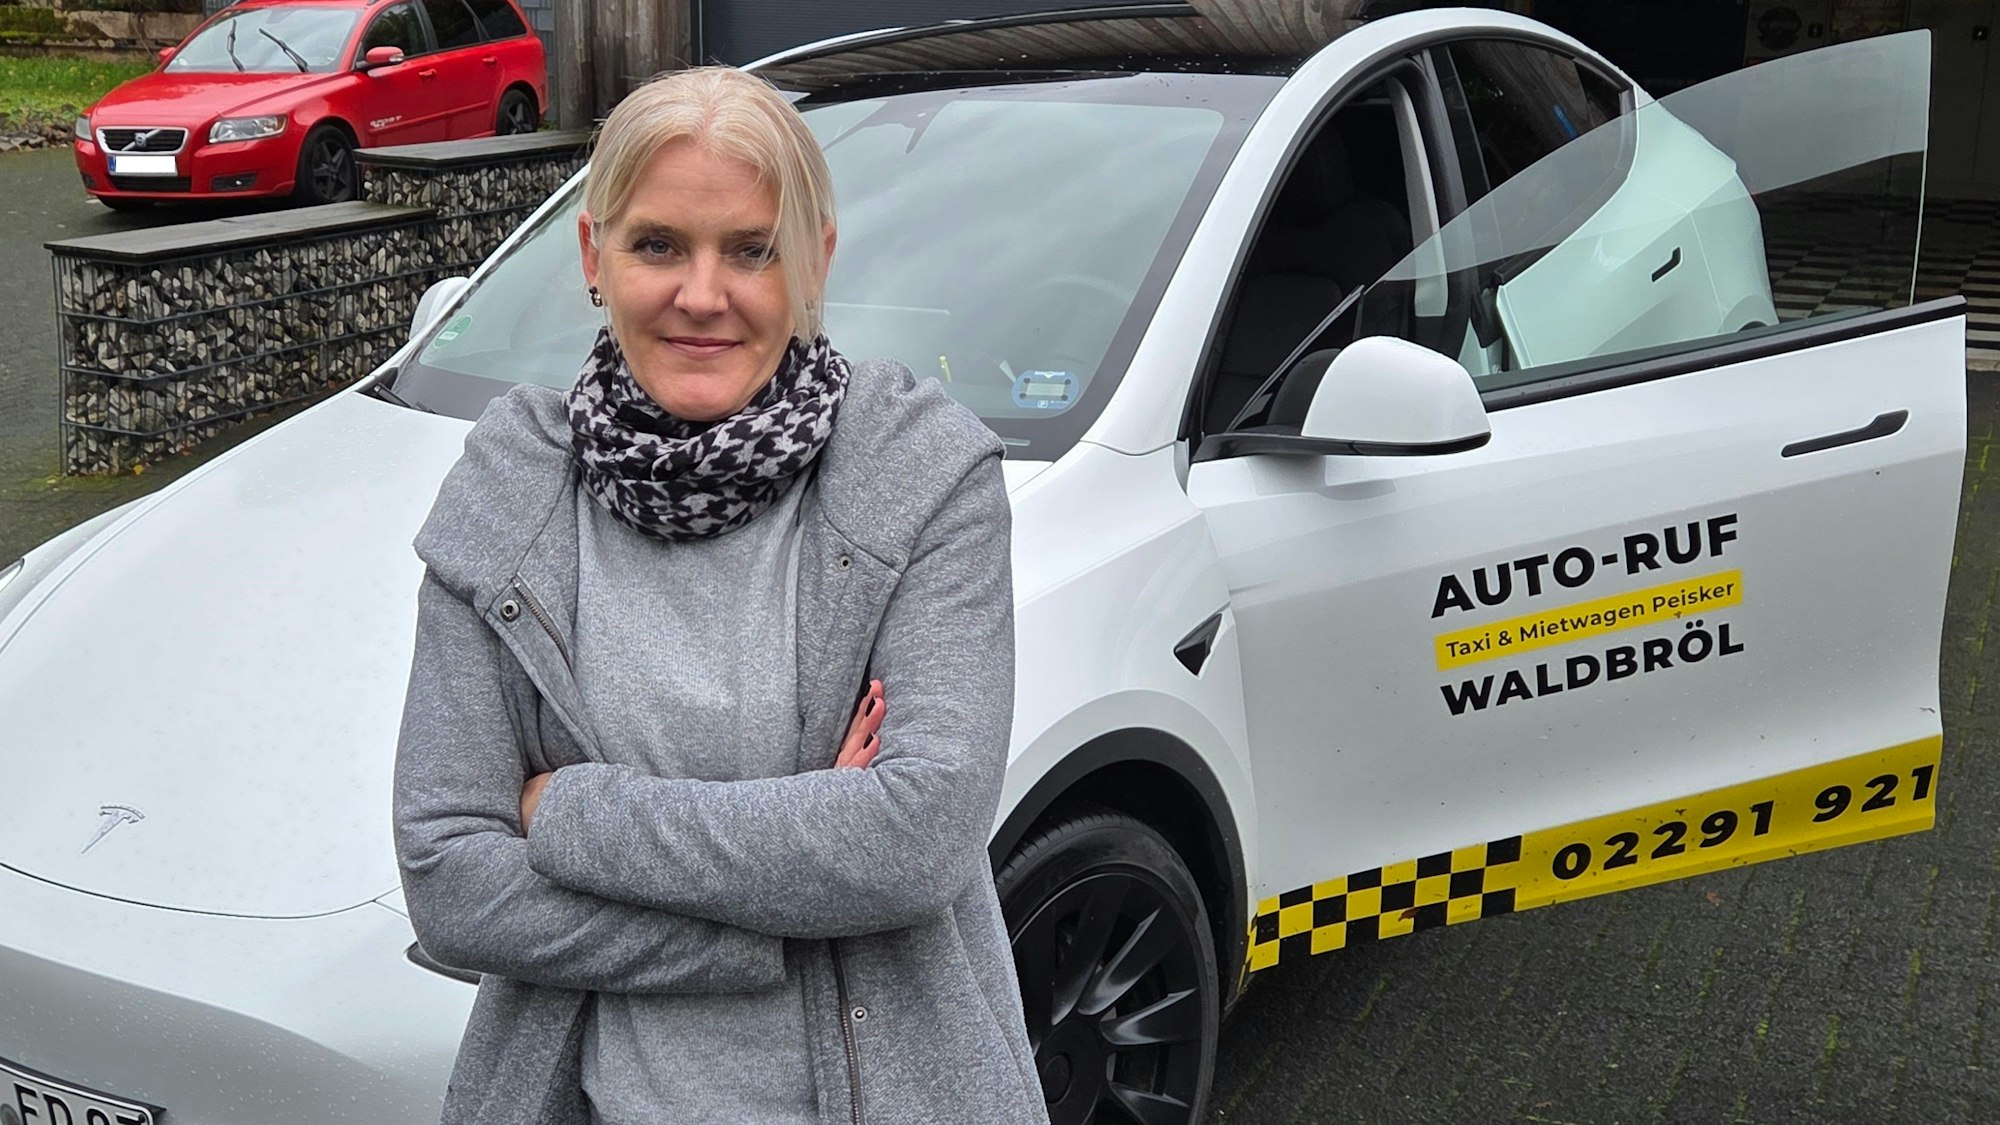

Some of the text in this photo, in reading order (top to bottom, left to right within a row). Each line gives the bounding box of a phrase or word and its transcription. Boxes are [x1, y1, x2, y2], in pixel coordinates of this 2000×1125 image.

[1431, 513, 1738, 619] AUTO-RUF
[1440, 619, 1745, 716] WALDBRÖL
[1445, 582, 1735, 659] Taxi & Mietwagen Peisker
[1552, 764, 1935, 880] 02291 921
